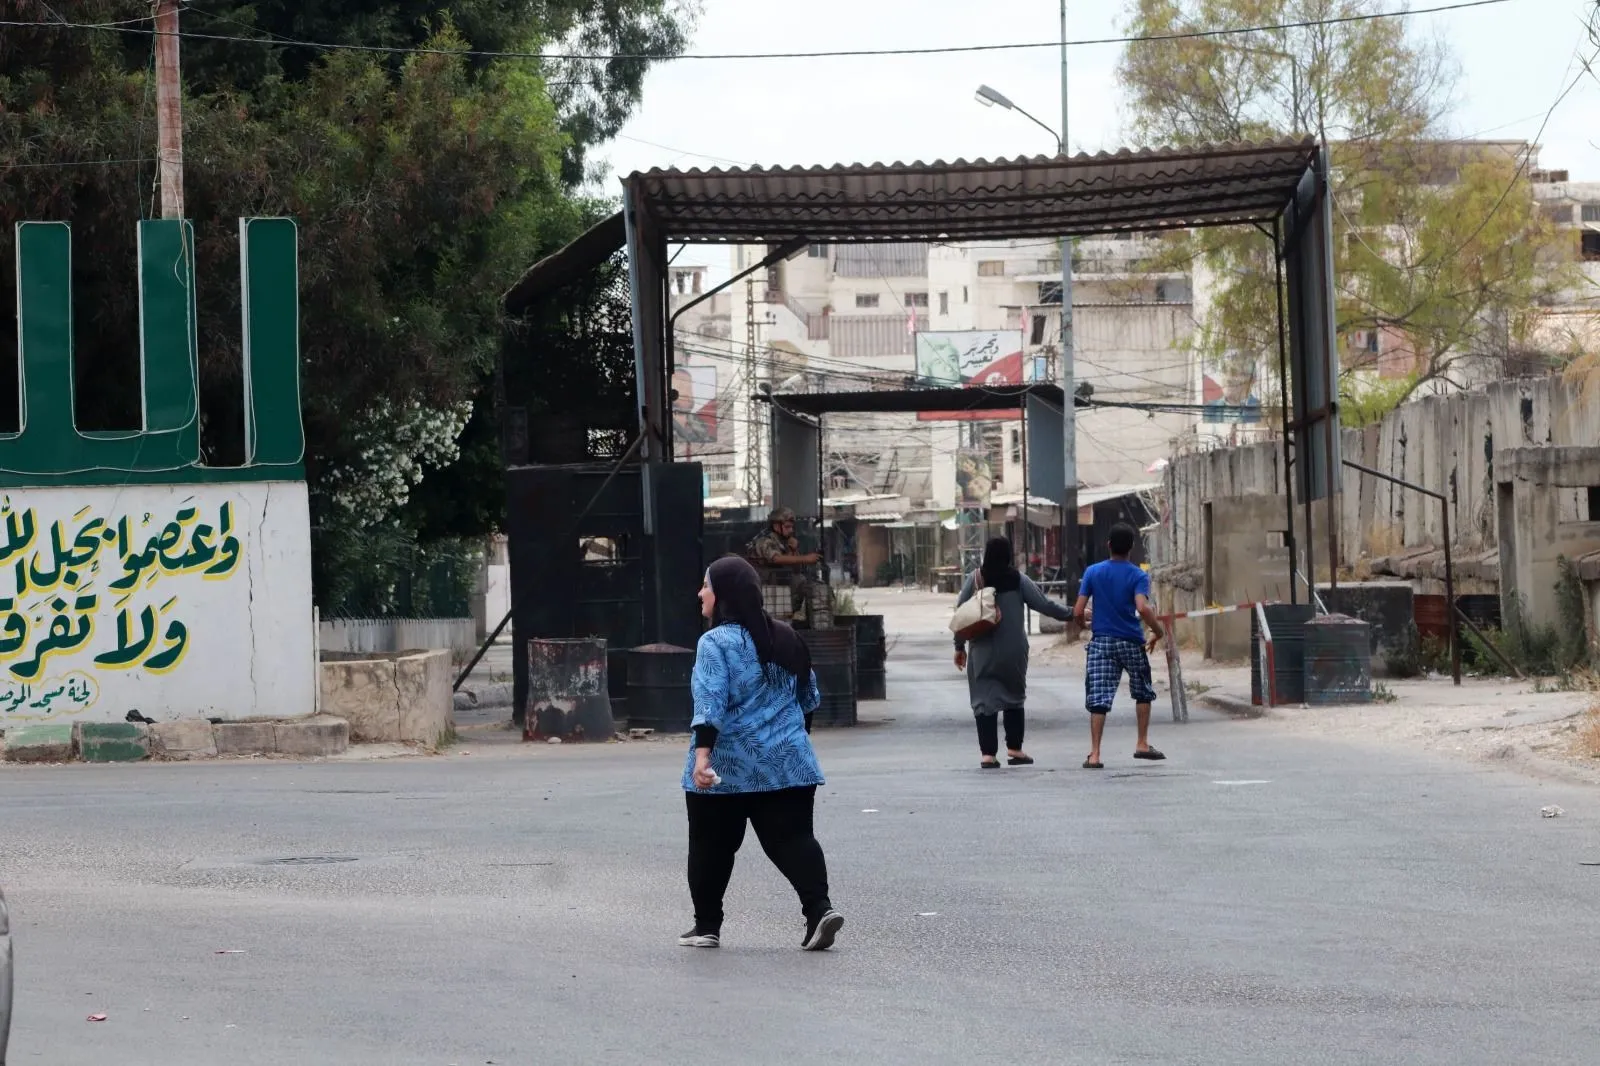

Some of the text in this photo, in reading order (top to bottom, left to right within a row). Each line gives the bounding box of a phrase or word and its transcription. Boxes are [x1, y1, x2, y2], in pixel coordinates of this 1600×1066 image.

[0, 217, 304, 474] الل
[0, 679, 91, 713] لجنة مسجد الموص
